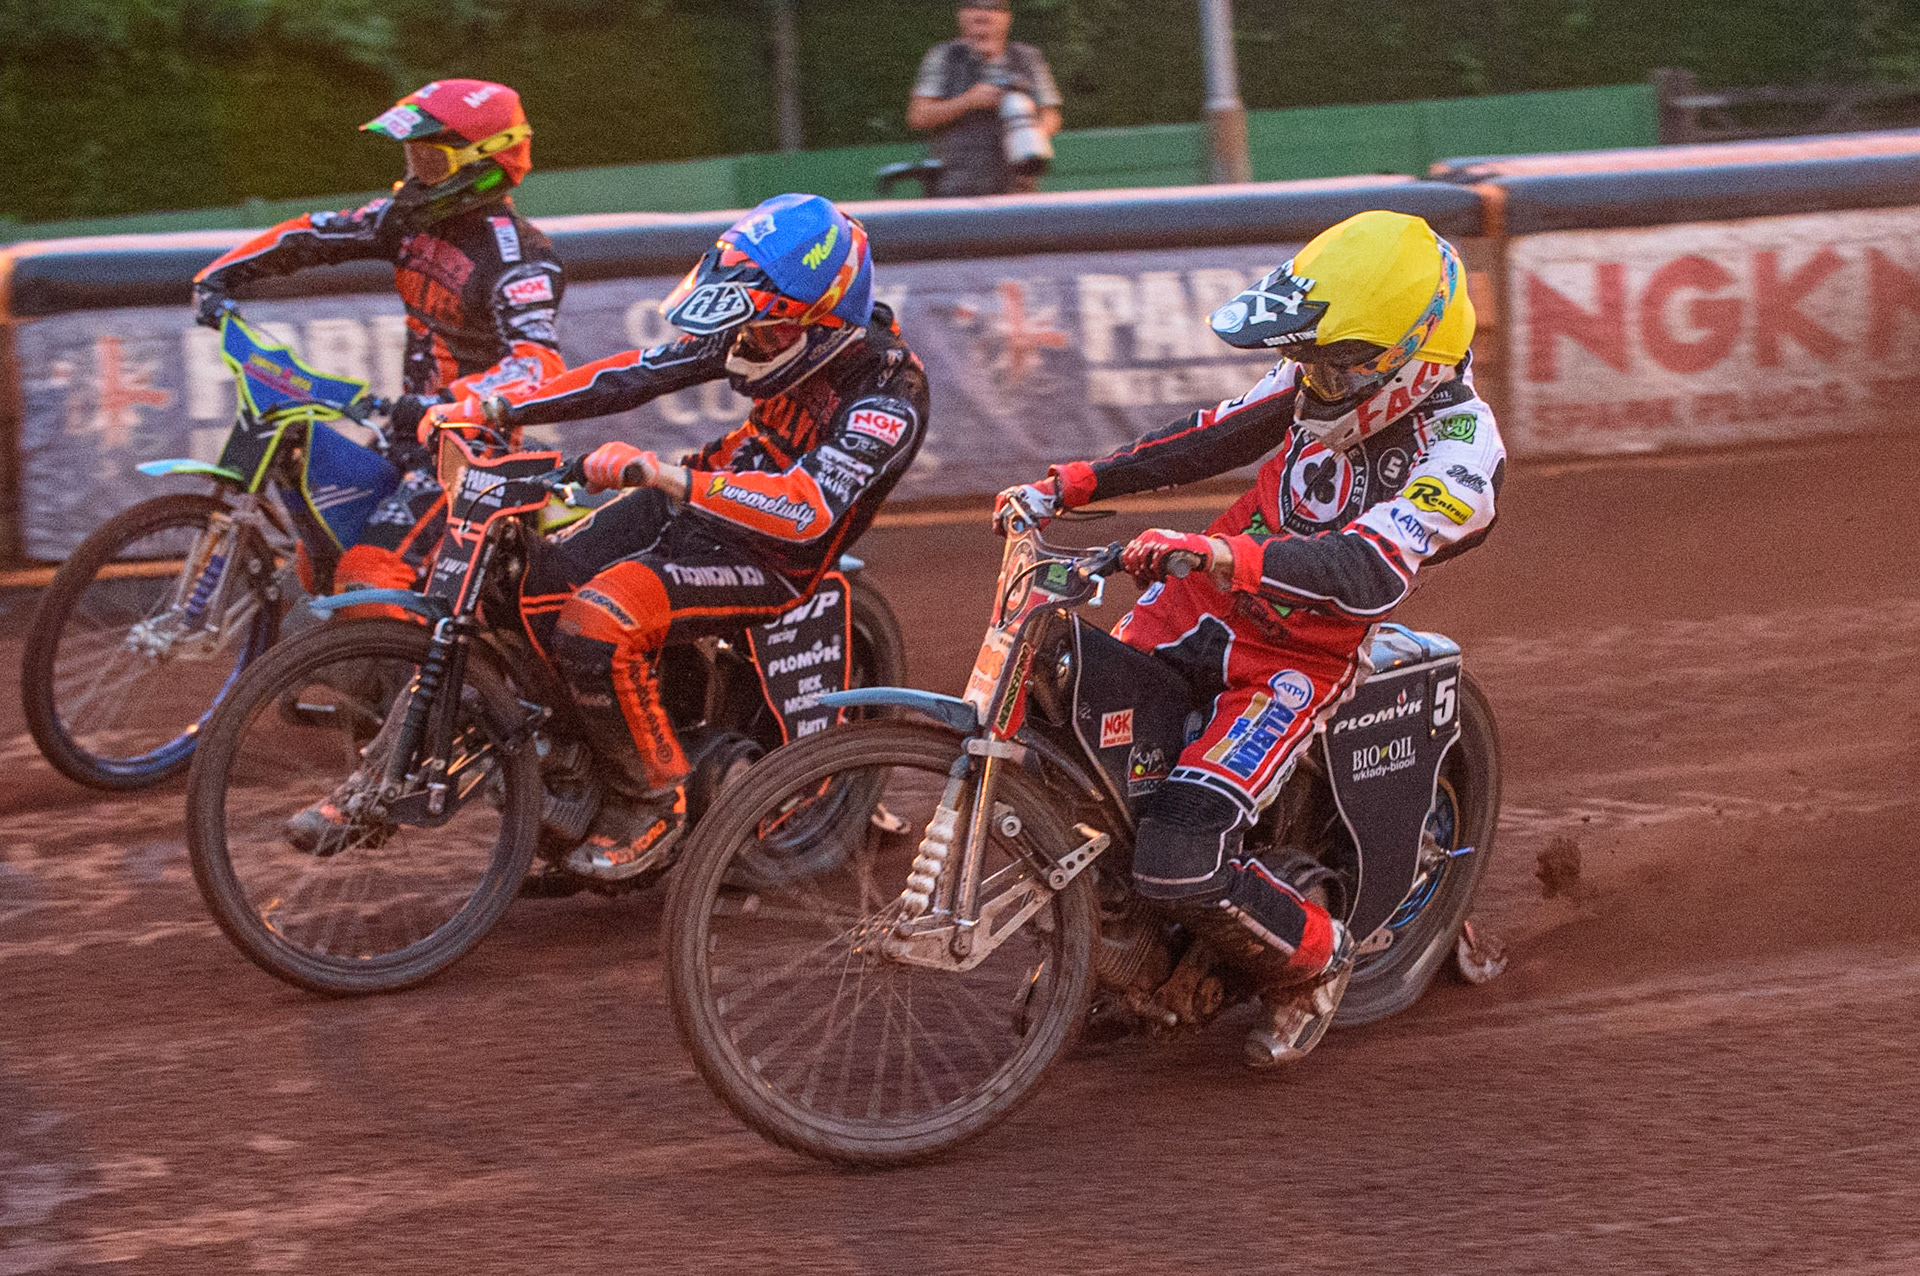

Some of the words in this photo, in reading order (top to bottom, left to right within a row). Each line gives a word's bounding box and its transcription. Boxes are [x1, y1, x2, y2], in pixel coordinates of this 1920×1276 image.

[1526, 246, 1843, 383] NGK
[852, 411, 904, 439] NGK
[1350, 465, 1366, 504] ACES
[1398, 513, 1426, 544] ATPI
[1277, 681, 1306, 702] ATPI
[1433, 675, 1457, 727] 5
[1103, 711, 1132, 738] NGK
[1332, 698, 1423, 735] PLOMYK
[1352, 744, 1381, 772] BIO
[1388, 735, 1416, 761] OIL
